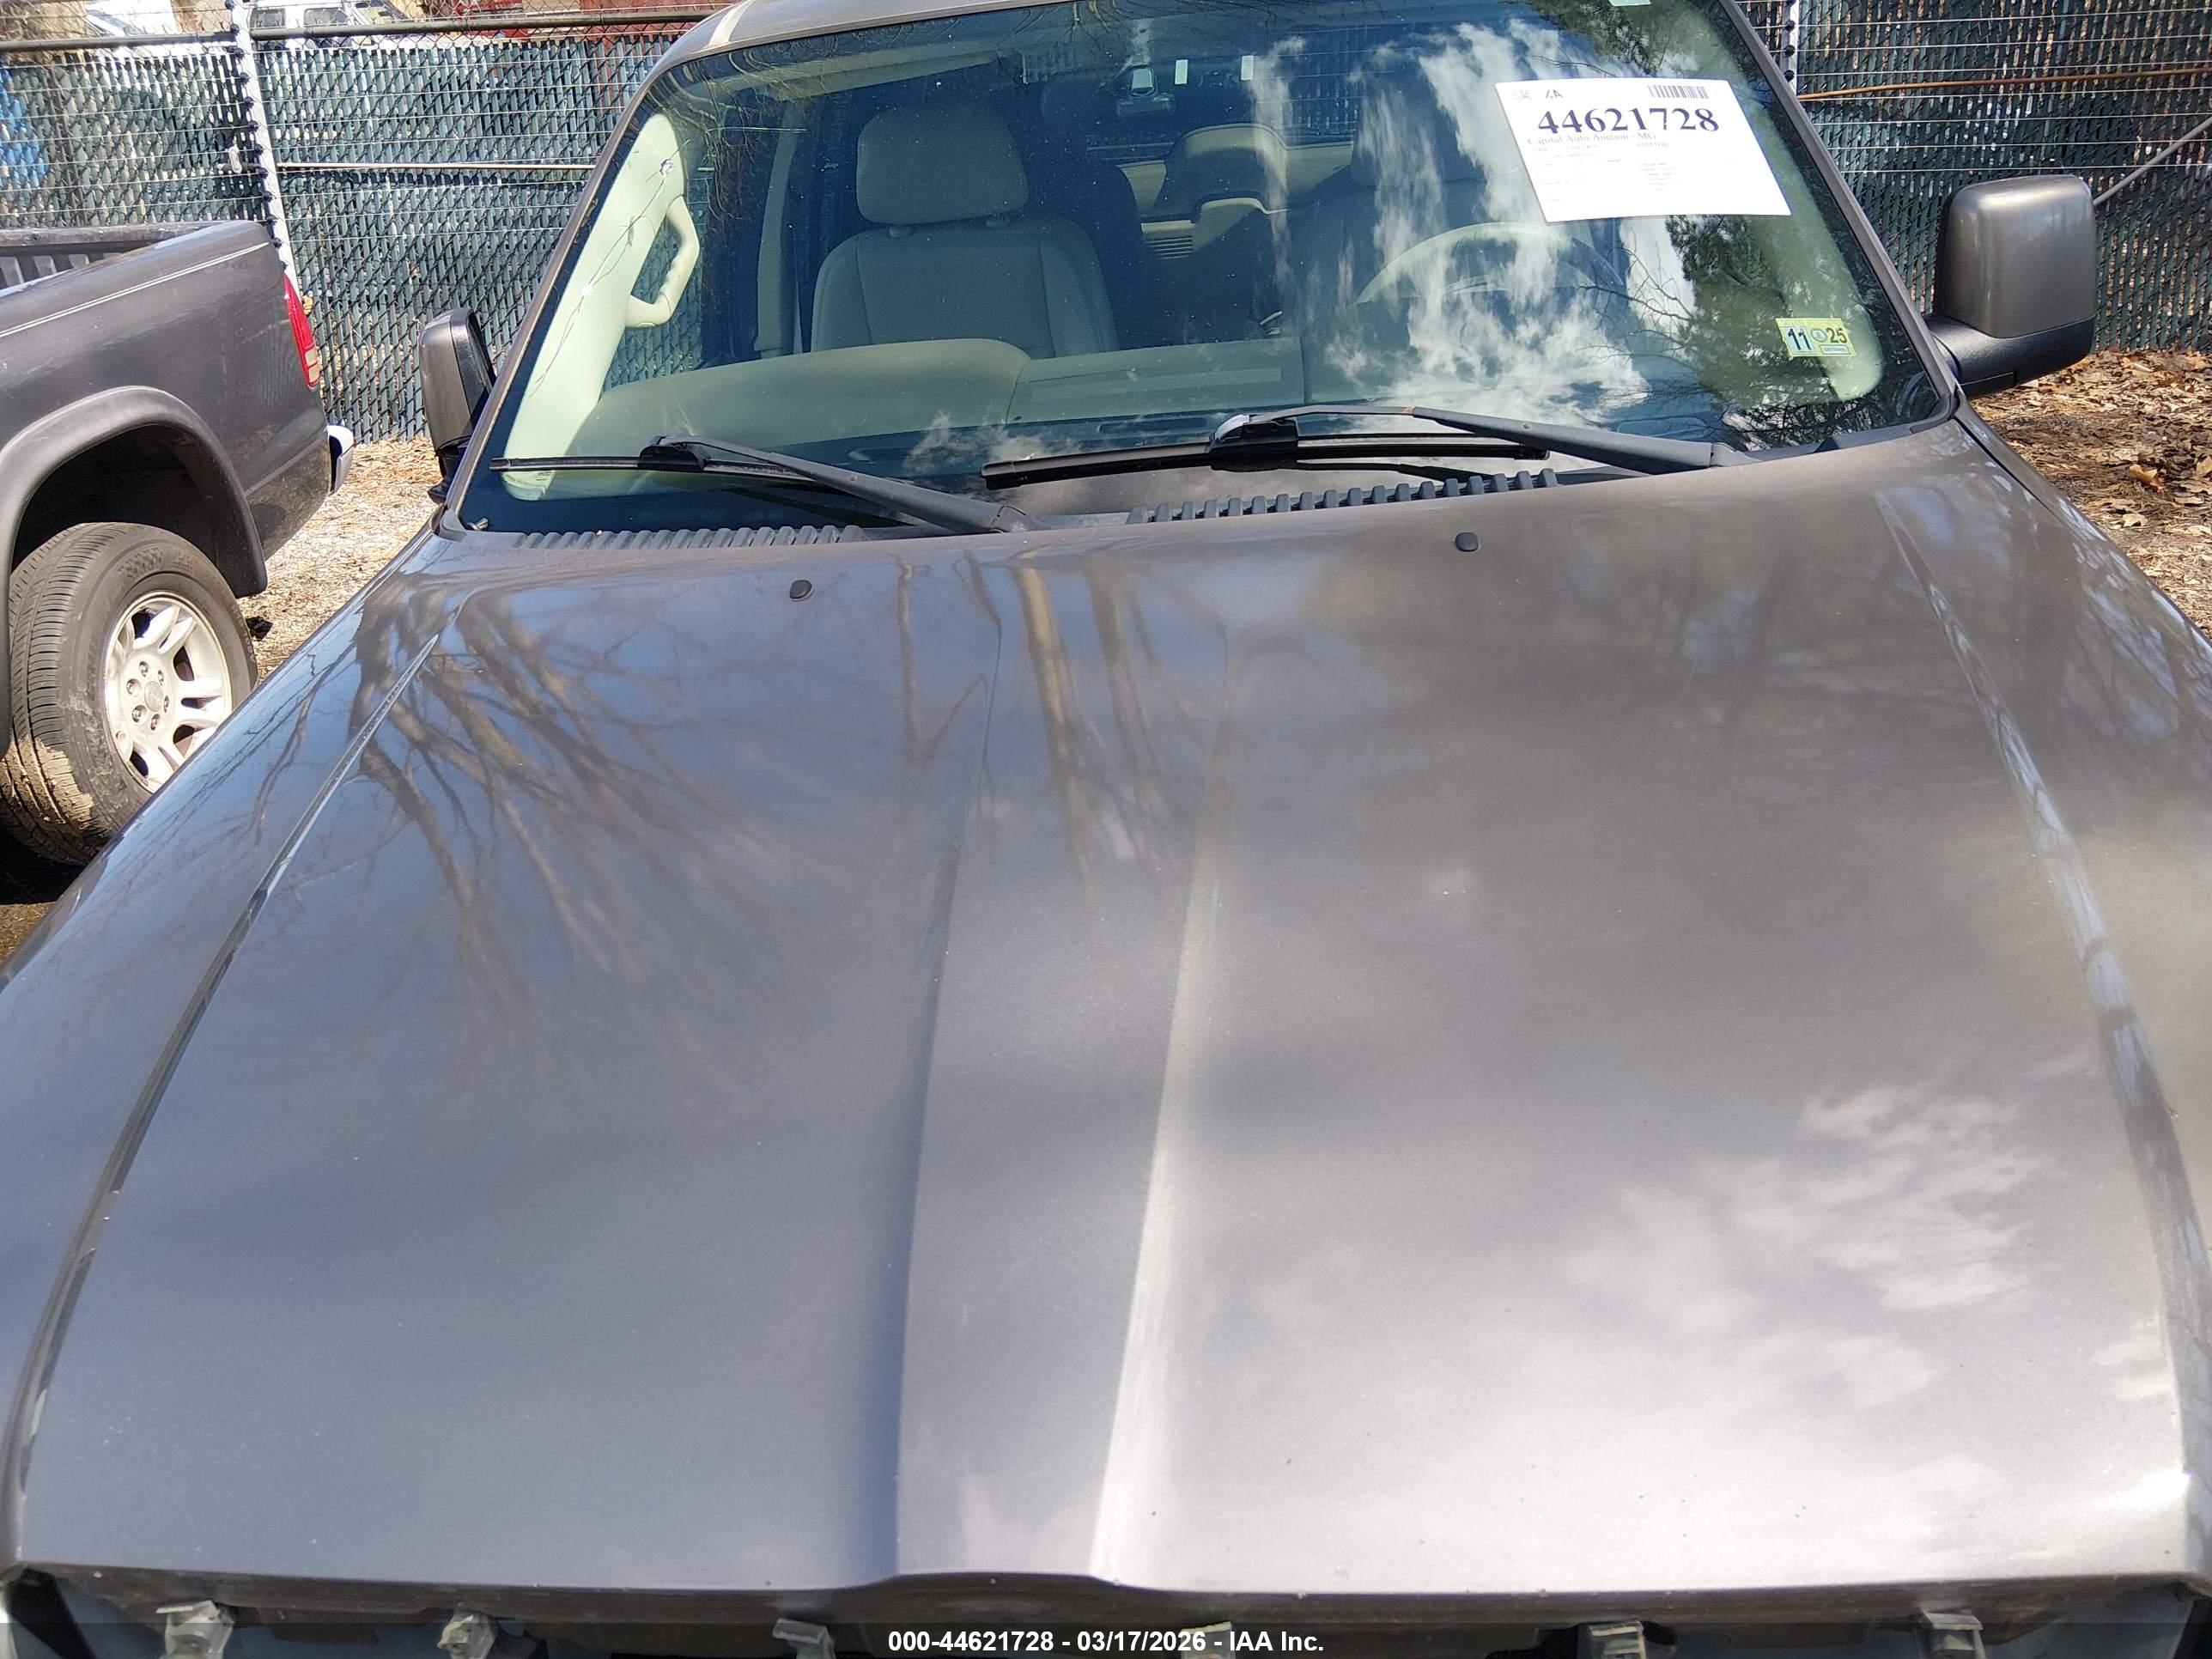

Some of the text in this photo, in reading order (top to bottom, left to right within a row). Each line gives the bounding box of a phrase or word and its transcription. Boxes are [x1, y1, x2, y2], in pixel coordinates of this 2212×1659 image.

[1537, 107, 1719, 134] 44621728
[1788, 327, 1847, 350] 11 25
